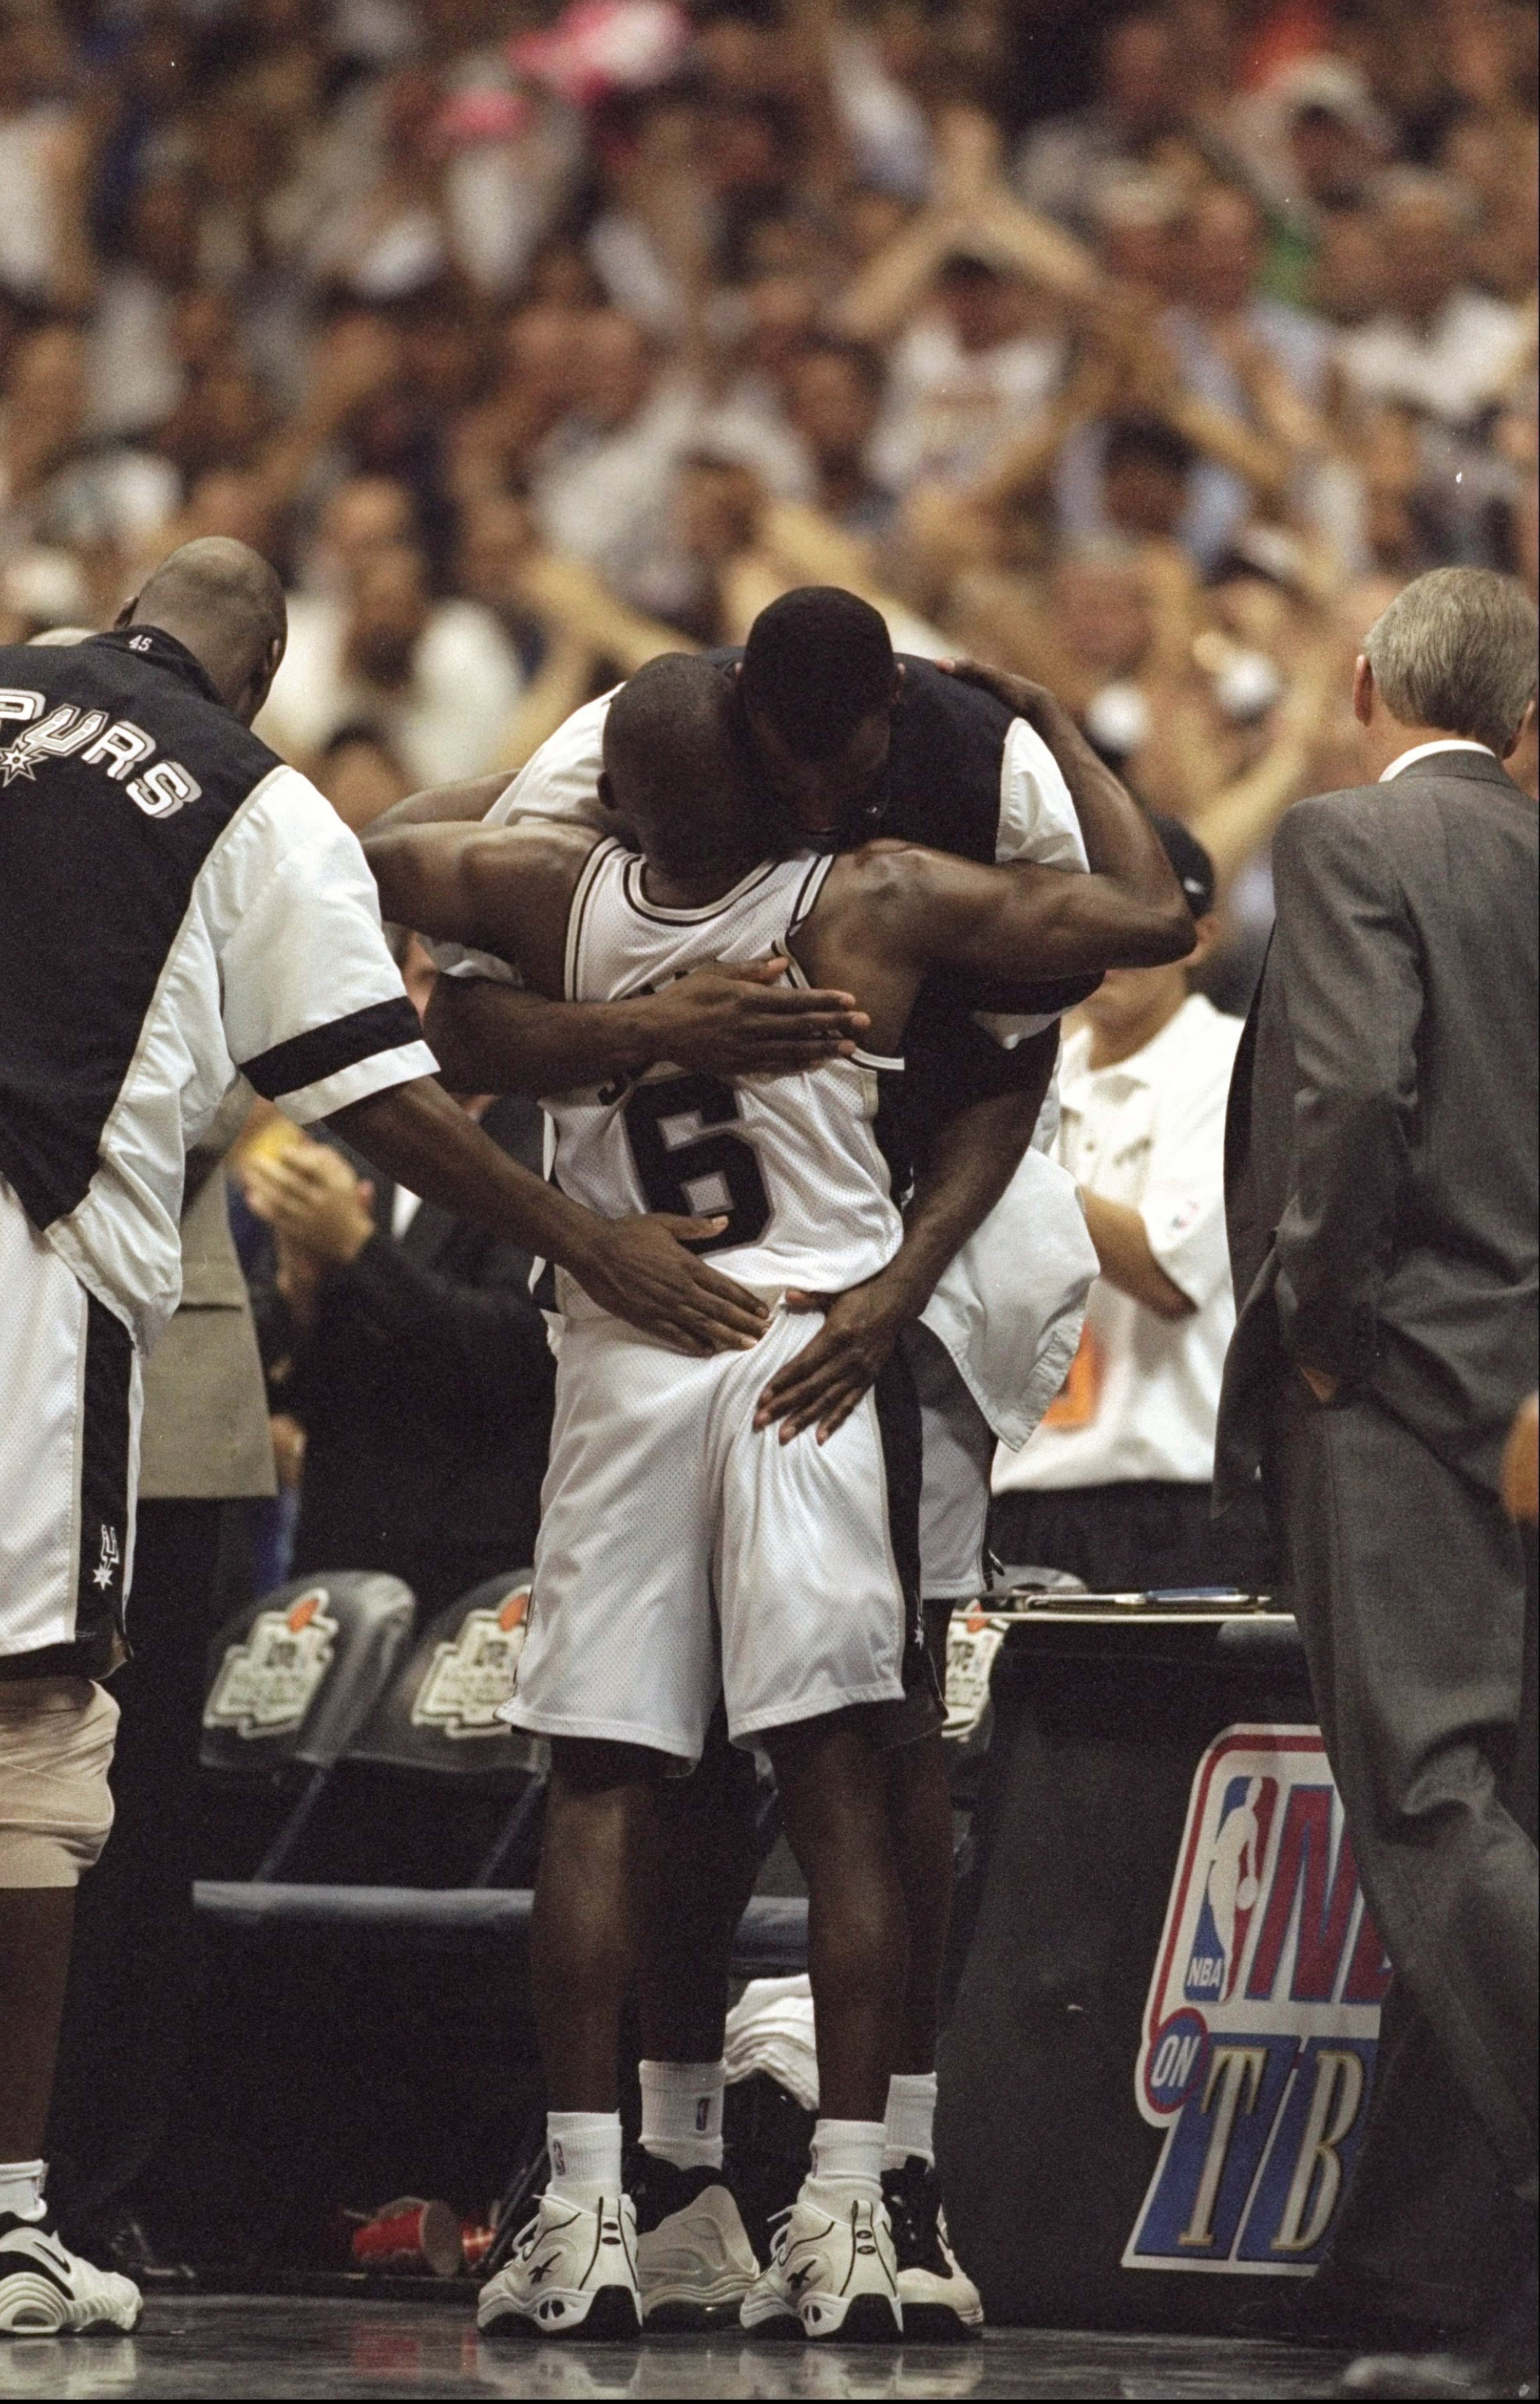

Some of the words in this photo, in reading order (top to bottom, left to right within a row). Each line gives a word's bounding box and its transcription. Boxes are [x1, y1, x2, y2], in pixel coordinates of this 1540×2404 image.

[129, 634, 152, 651] 45
[622, 1070, 775, 1255] 6
[1244, 1784, 1395, 2004] N
[1186, 1957, 1222, 1987] NBA
[1151, 2034, 1202, 2088] ON
